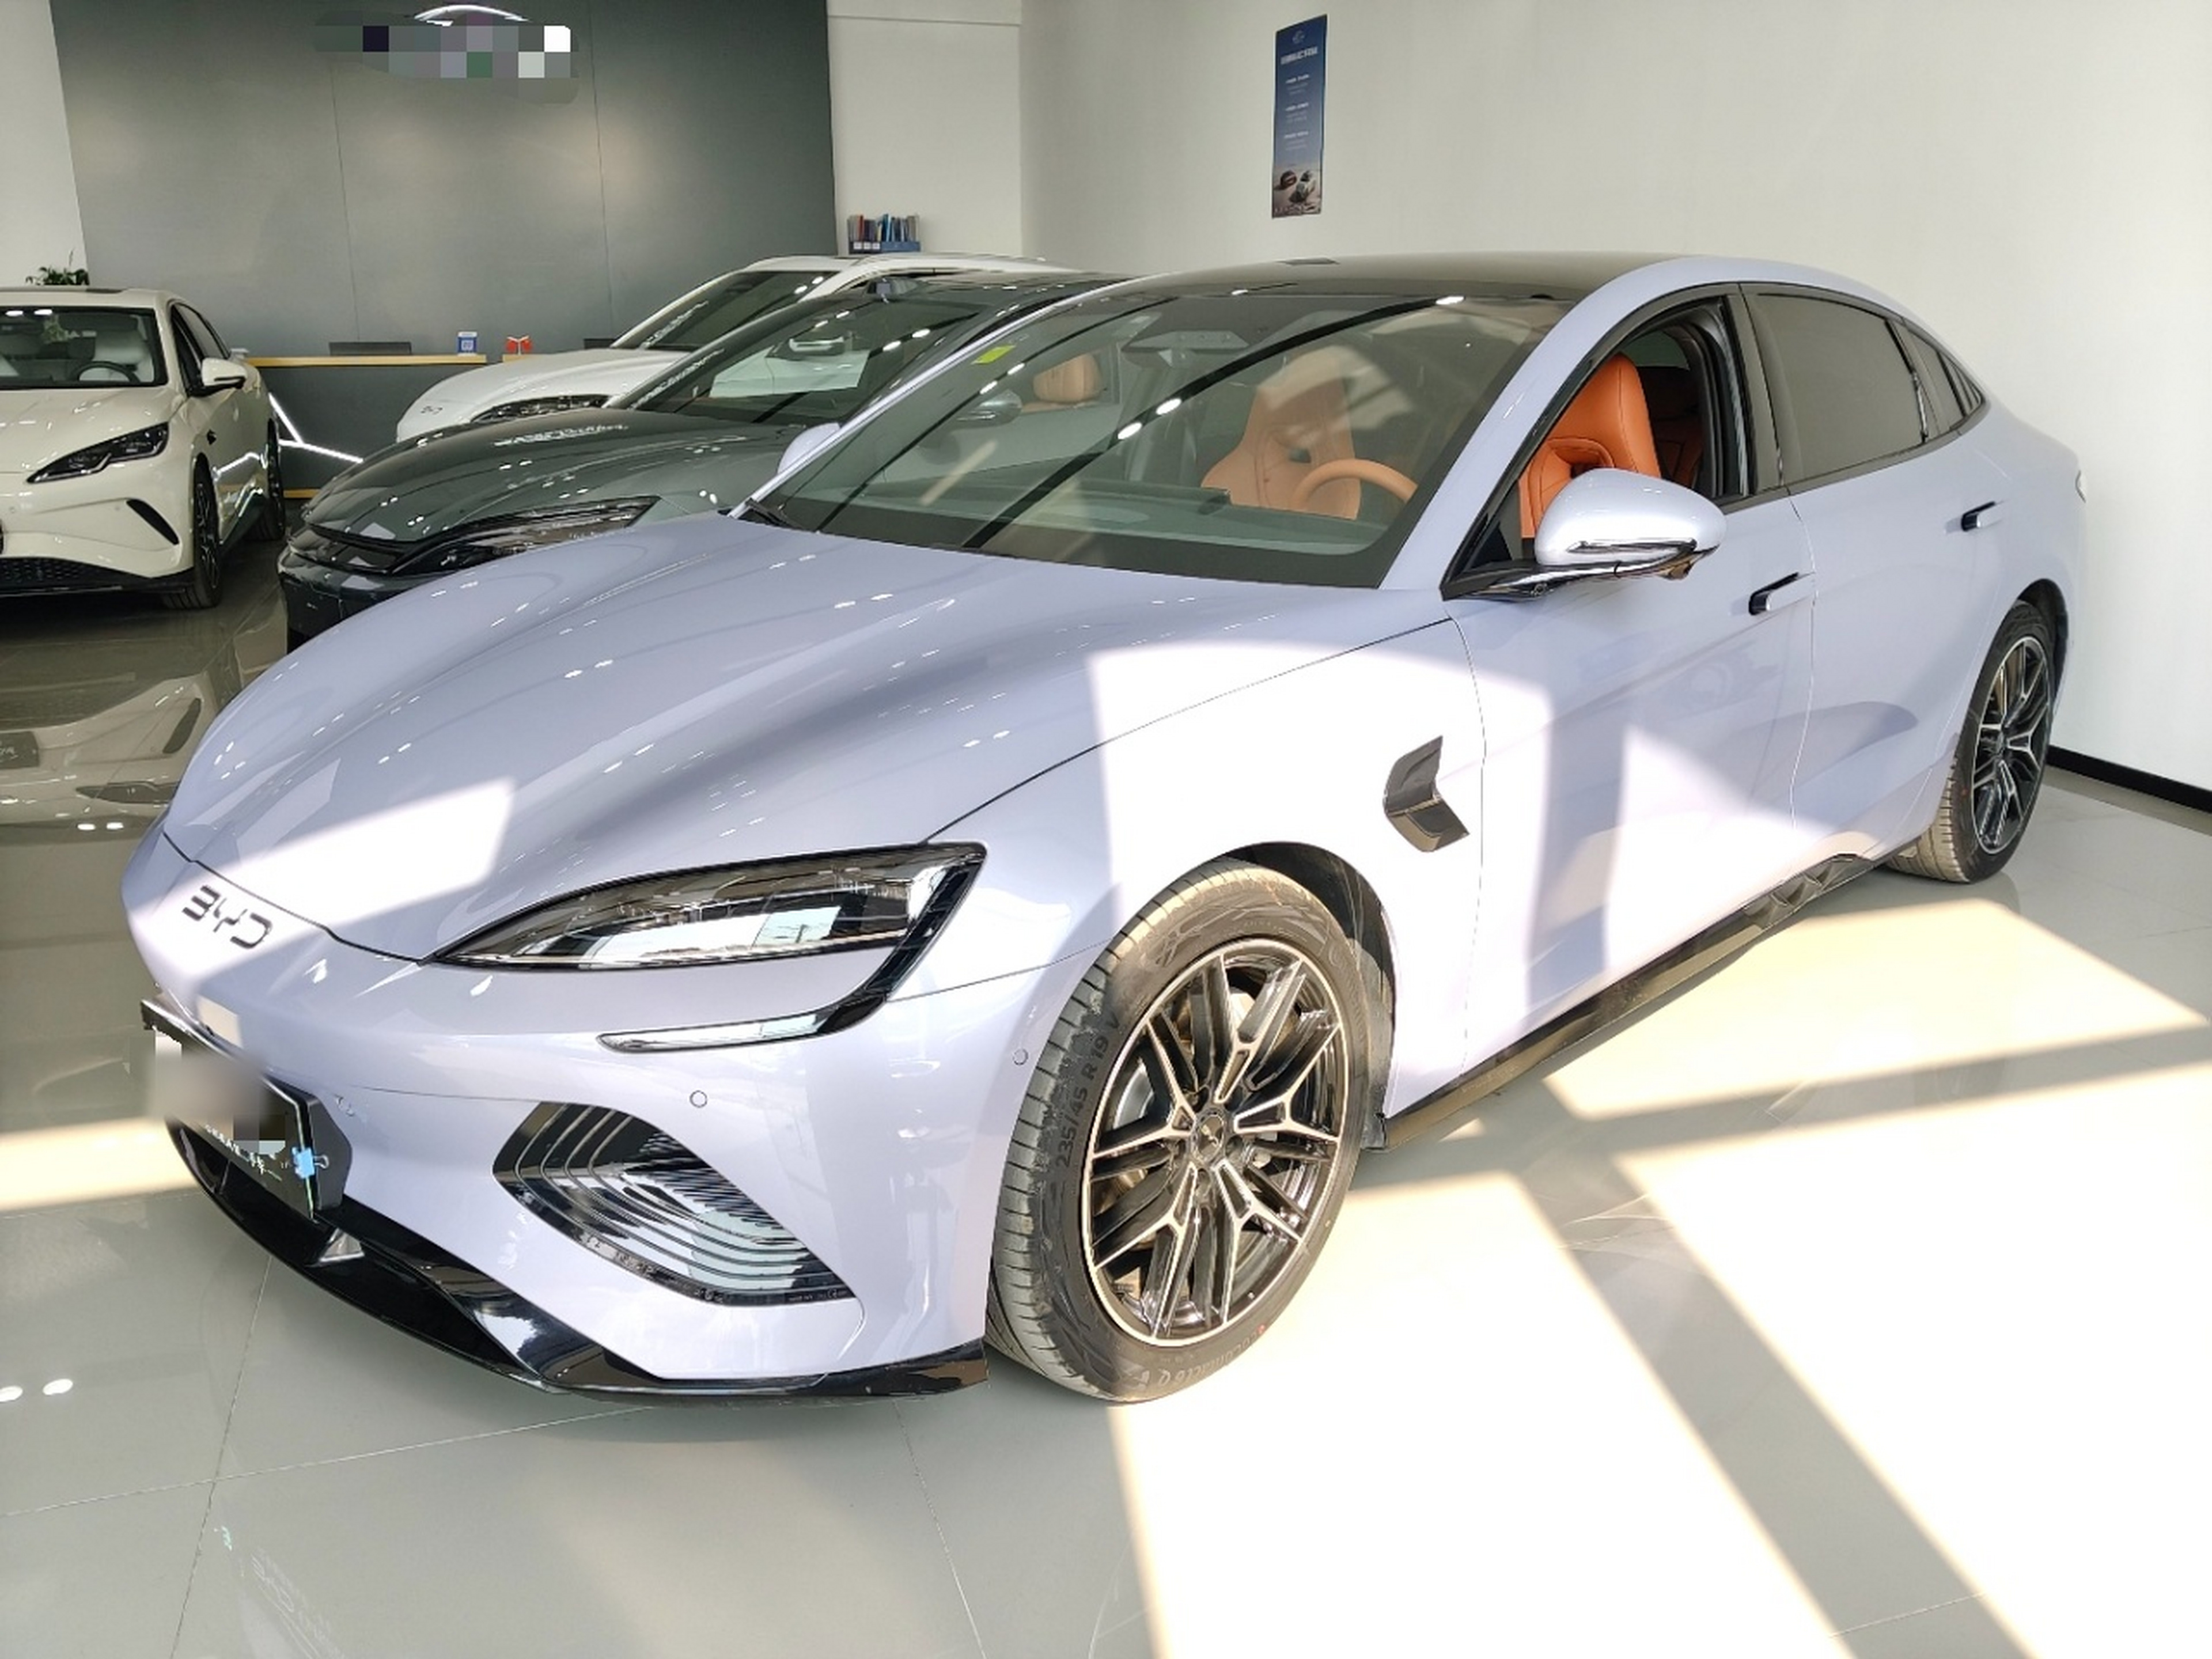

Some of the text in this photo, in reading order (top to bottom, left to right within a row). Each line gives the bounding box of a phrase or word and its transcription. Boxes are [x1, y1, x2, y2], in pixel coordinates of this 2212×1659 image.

[181, 885, 273, 949] BYD
[1055, 1086, 1088, 1167] 235/45
[1081, 1062, 1097, 1081] R
[1092, 1036, 1109, 1059] 19
